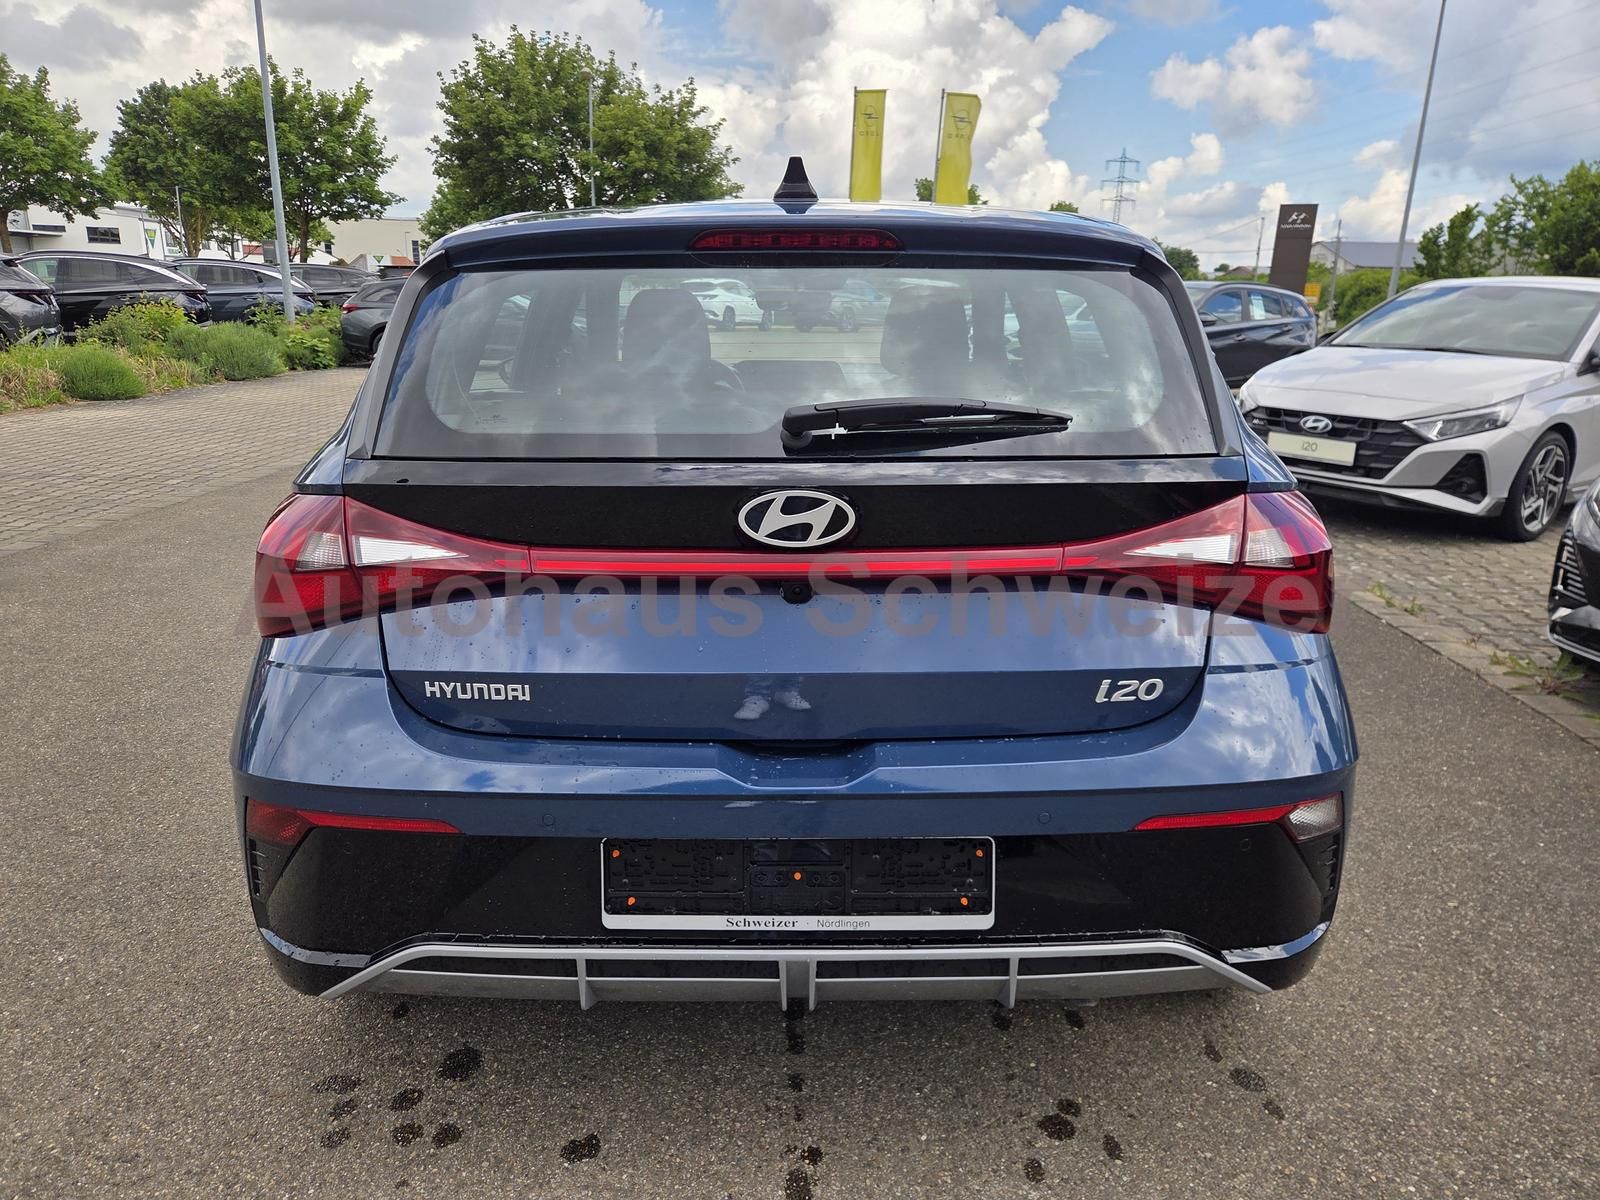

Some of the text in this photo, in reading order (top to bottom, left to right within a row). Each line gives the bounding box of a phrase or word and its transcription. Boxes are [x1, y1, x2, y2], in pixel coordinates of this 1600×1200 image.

[424, 681, 531, 701] HYUNDAI
[1095, 678, 1164, 703] i20
[726, 917, 799, 928] Schweizer
